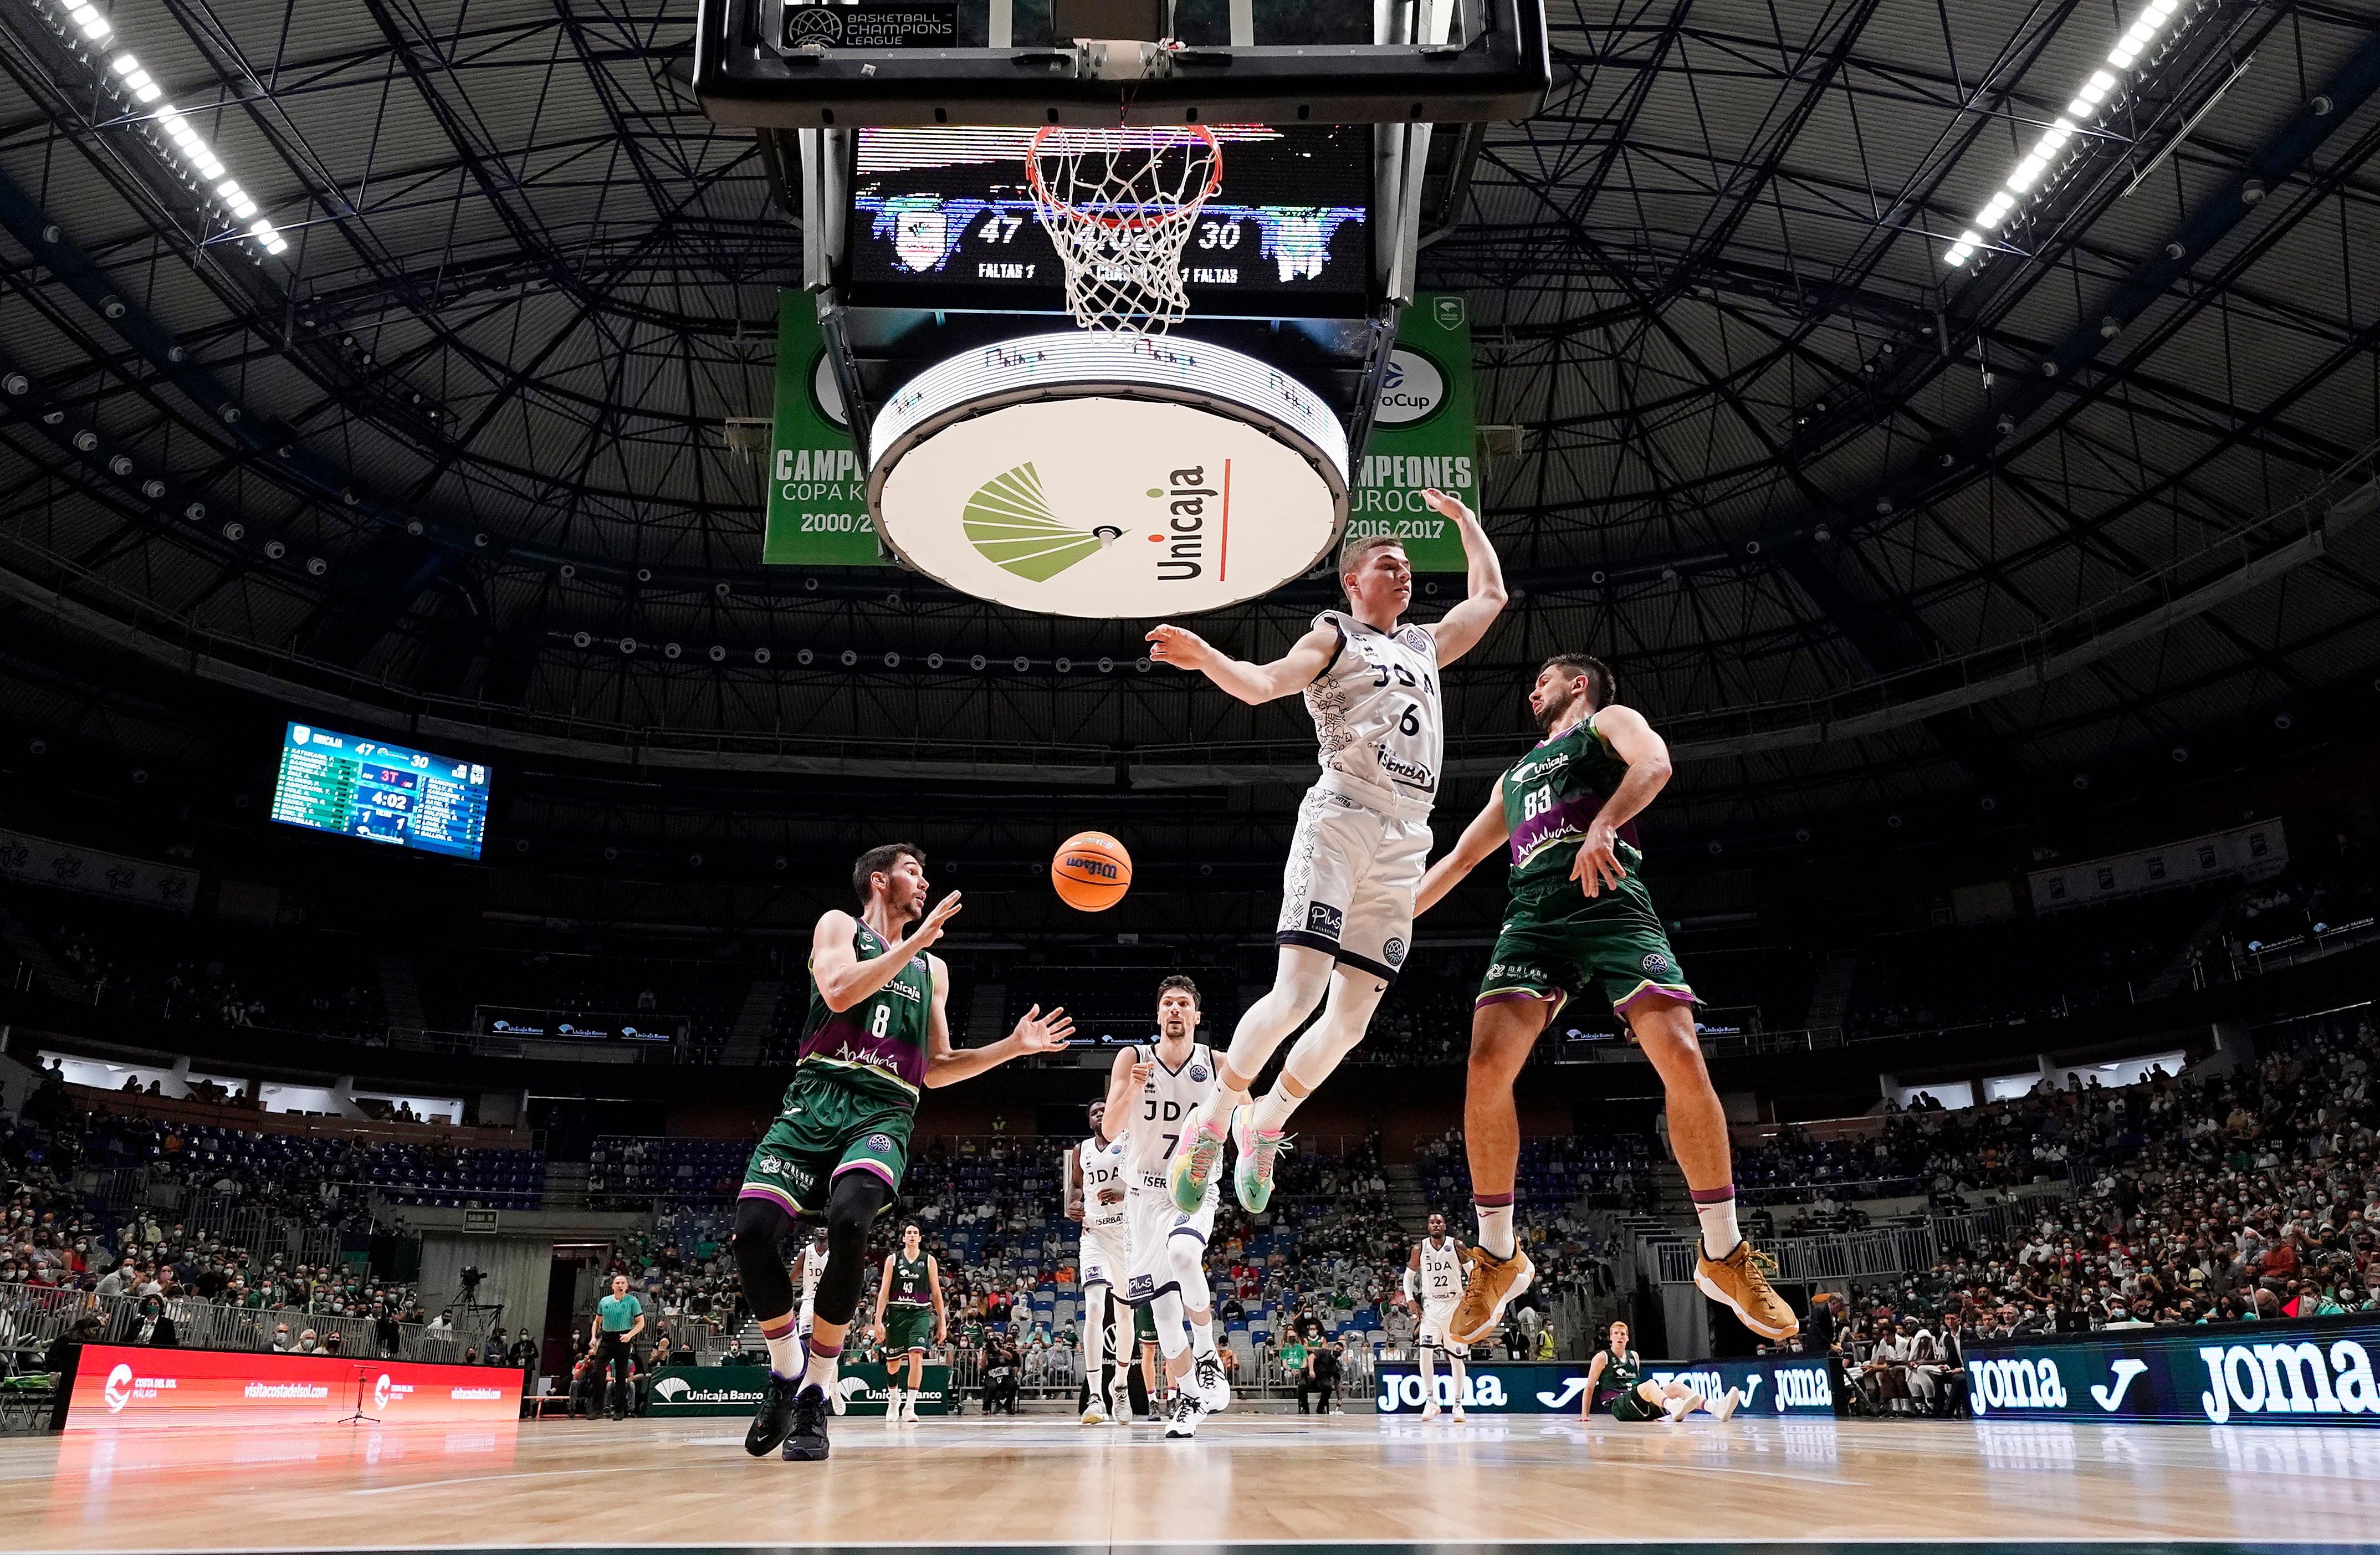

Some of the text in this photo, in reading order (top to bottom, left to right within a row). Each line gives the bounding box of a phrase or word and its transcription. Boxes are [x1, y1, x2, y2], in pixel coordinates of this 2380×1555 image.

[848, 13, 940, 23] BASKETBALL
[847, 23, 952, 35] CHAMPIONS
[846, 36, 903, 45] LEAGUE
[977, 217, 1023, 243] 47
[1197, 221, 1241, 249] 30
[1194, 268, 1238, 283] FALTAS
[1379, 393, 1430, 410] oCup
[782, 483, 867, 501] COPA K
[801, 513, 878, 533] 2000/2
[1147, 466, 1219, 581] Unicaja
[1373, 663, 1434, 697] JDA
[1399, 704, 1420, 736] 6
[313, 733, 342, 748] UNICAJA
[355, 743, 375, 756] 47
[410, 754, 429, 769] 30
[1534, 753, 1569, 774] Unicaja
[381, 770, 399, 783] 3T
[372, 791, 407, 810] 4:02
[1524, 784, 1552, 822] 83
[362, 811, 371, 823] 1
[396, 818, 405, 830] 1
[1066, 857, 1117, 879] Wilson
[1312, 906, 1340, 929] Plus
[885, 980, 920, 999] Unicaja
[872, 1004, 890, 1038] 8
[1162, 1134, 1180, 1160] 7
[1088, 1167, 1119, 1185] JDA
[1427, 1261, 1452, 1272] JDA
[903, 1282, 913, 1293] 43
[1129, 1277, 1153, 1293] Plus
[1434, 1275, 1448, 1287] 22
[135, 1378, 153, 1388] COSTA
[244, 1382, 328, 1398] visitacostadelsol.com
[687, 1389, 763, 1403] Unicaja Banco
